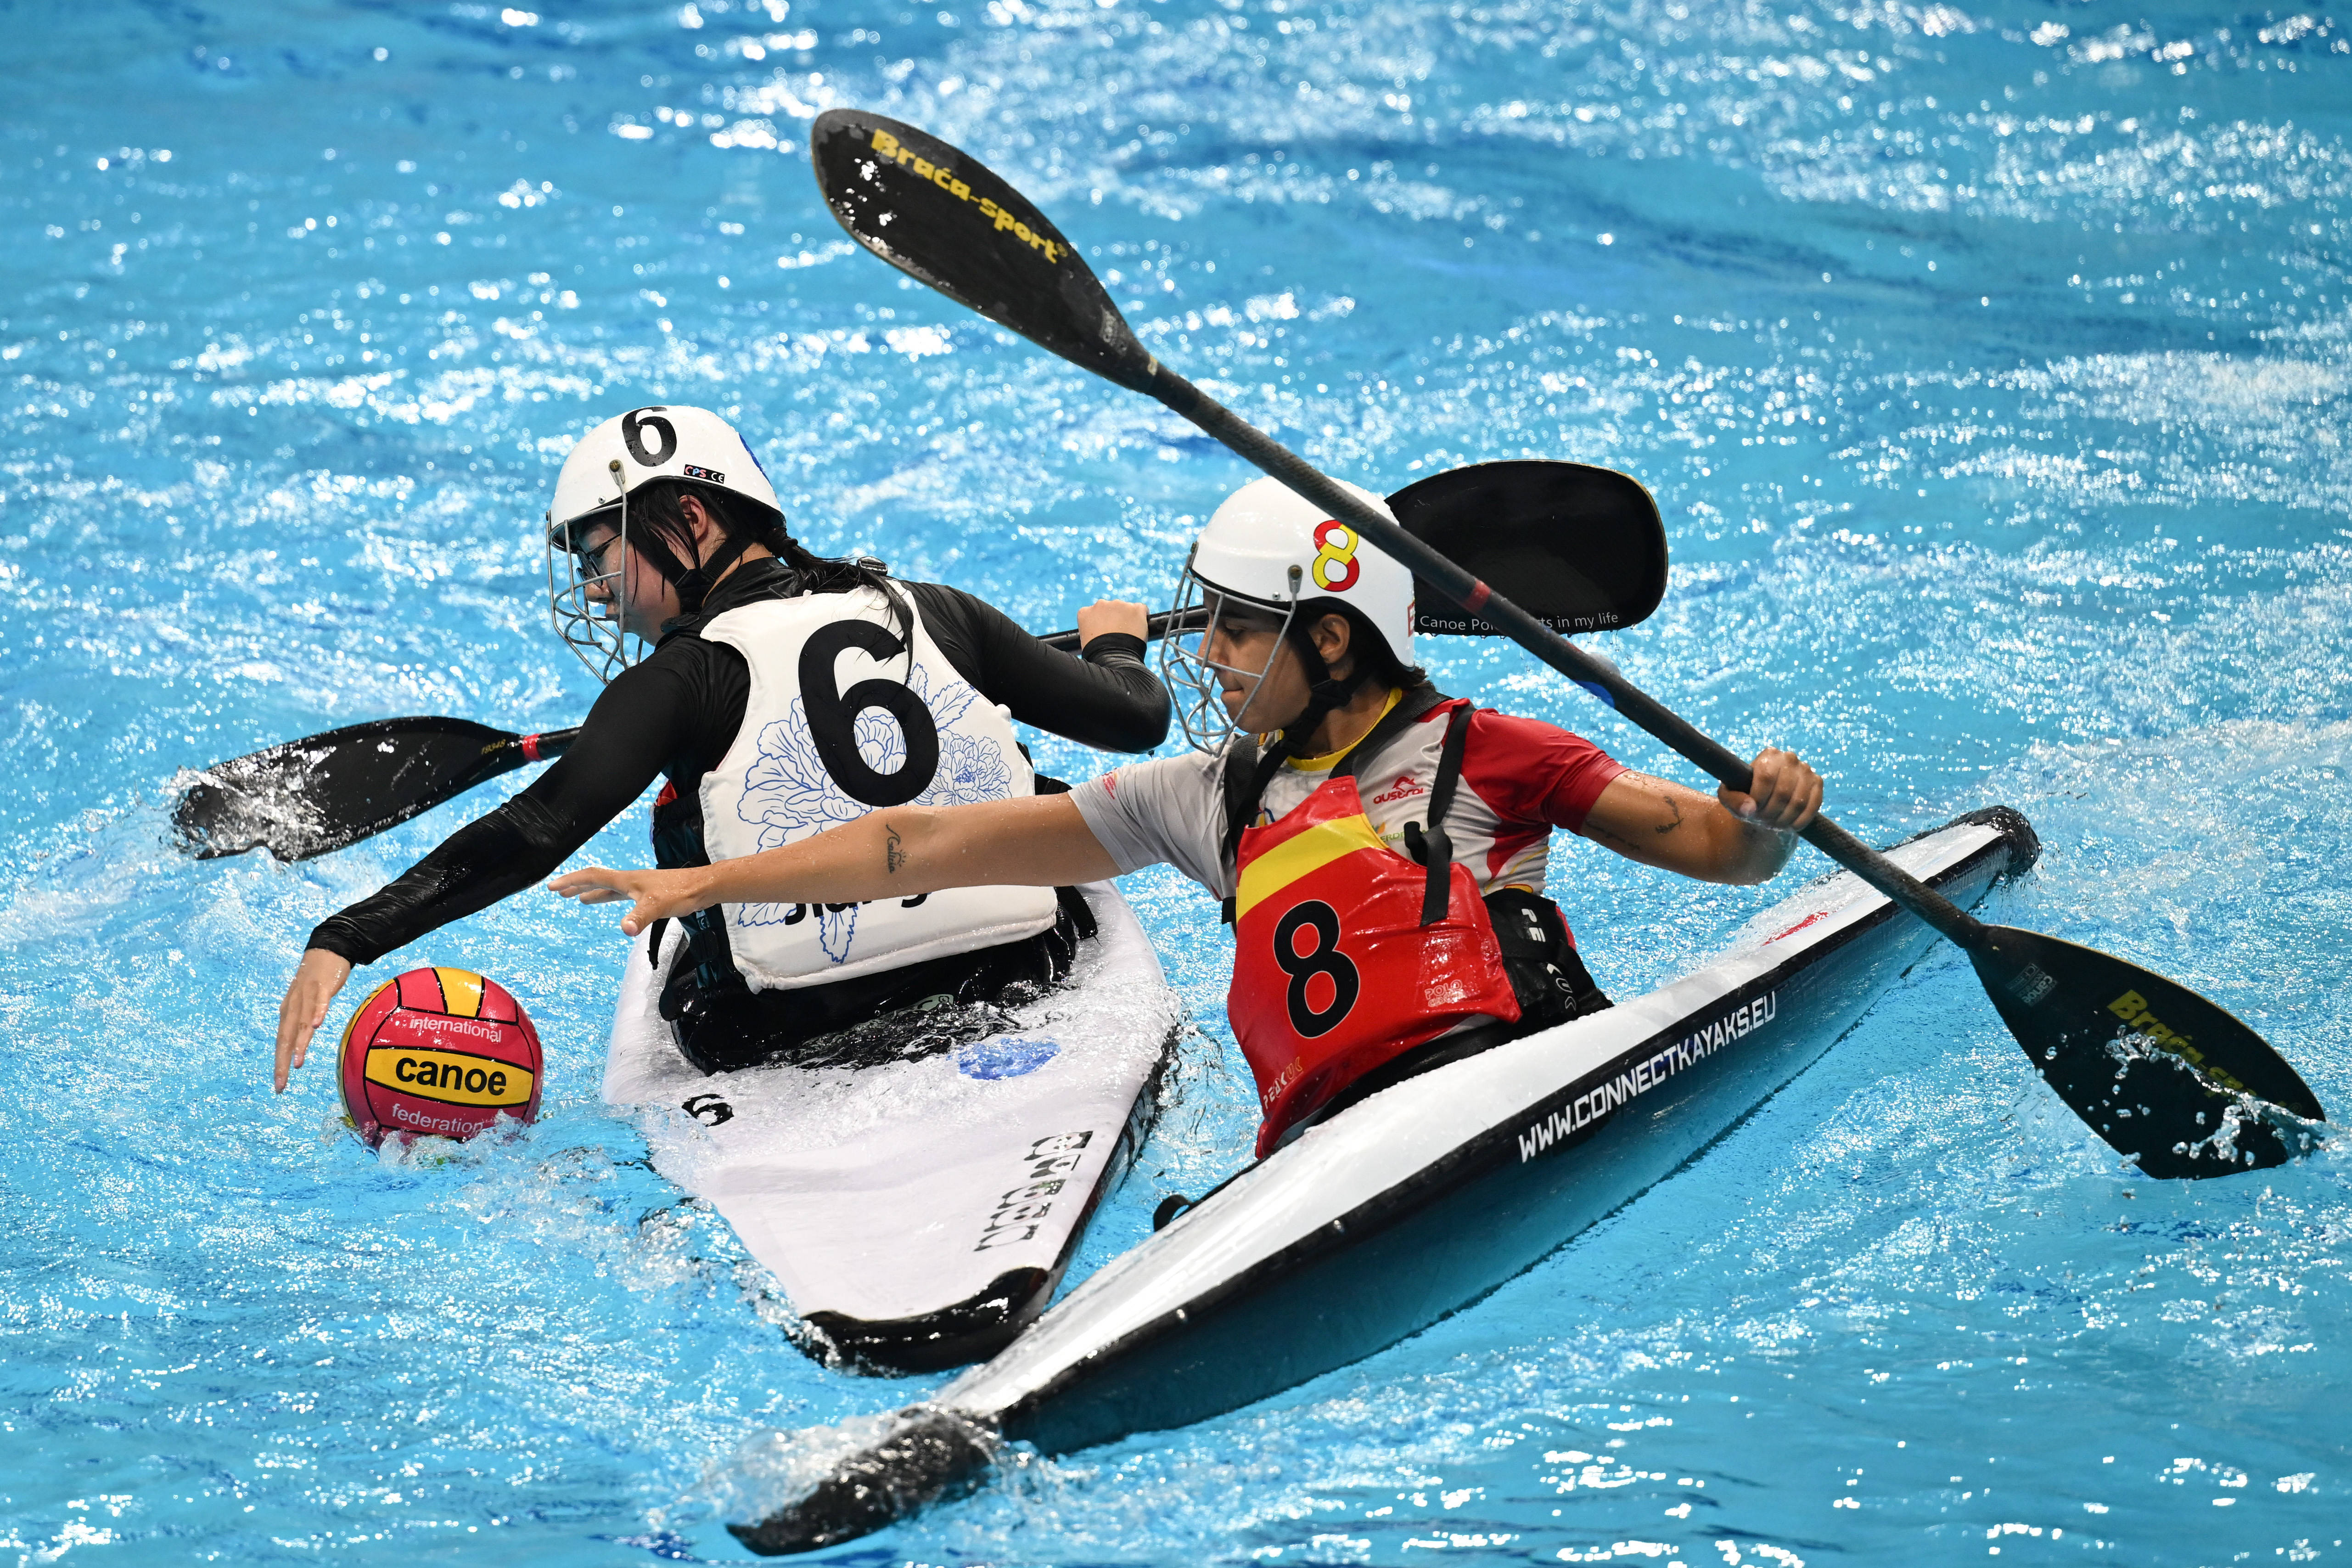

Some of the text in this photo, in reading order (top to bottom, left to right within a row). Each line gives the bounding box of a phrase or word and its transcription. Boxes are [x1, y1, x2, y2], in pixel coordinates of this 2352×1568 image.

[622, 406, 677, 467] 6
[685, 466, 724, 483] CPS CE
[1312, 519, 1359, 592] 8
[1420, 616, 1466, 630] Canoe
[1557, 616, 1570, 628] in
[1575, 617, 1594, 629] my
[1598, 612, 1618, 624] life
[798, 619, 939, 807] 6
[1273, 899, 1360, 1038] 8
[409, 1016, 502, 1043] international
[395, 1057, 507, 1096] canoe
[1518, 991, 1776, 1163] WWW.CONNECTKAYAKS.EU
[392, 1103, 484, 1133] federation
